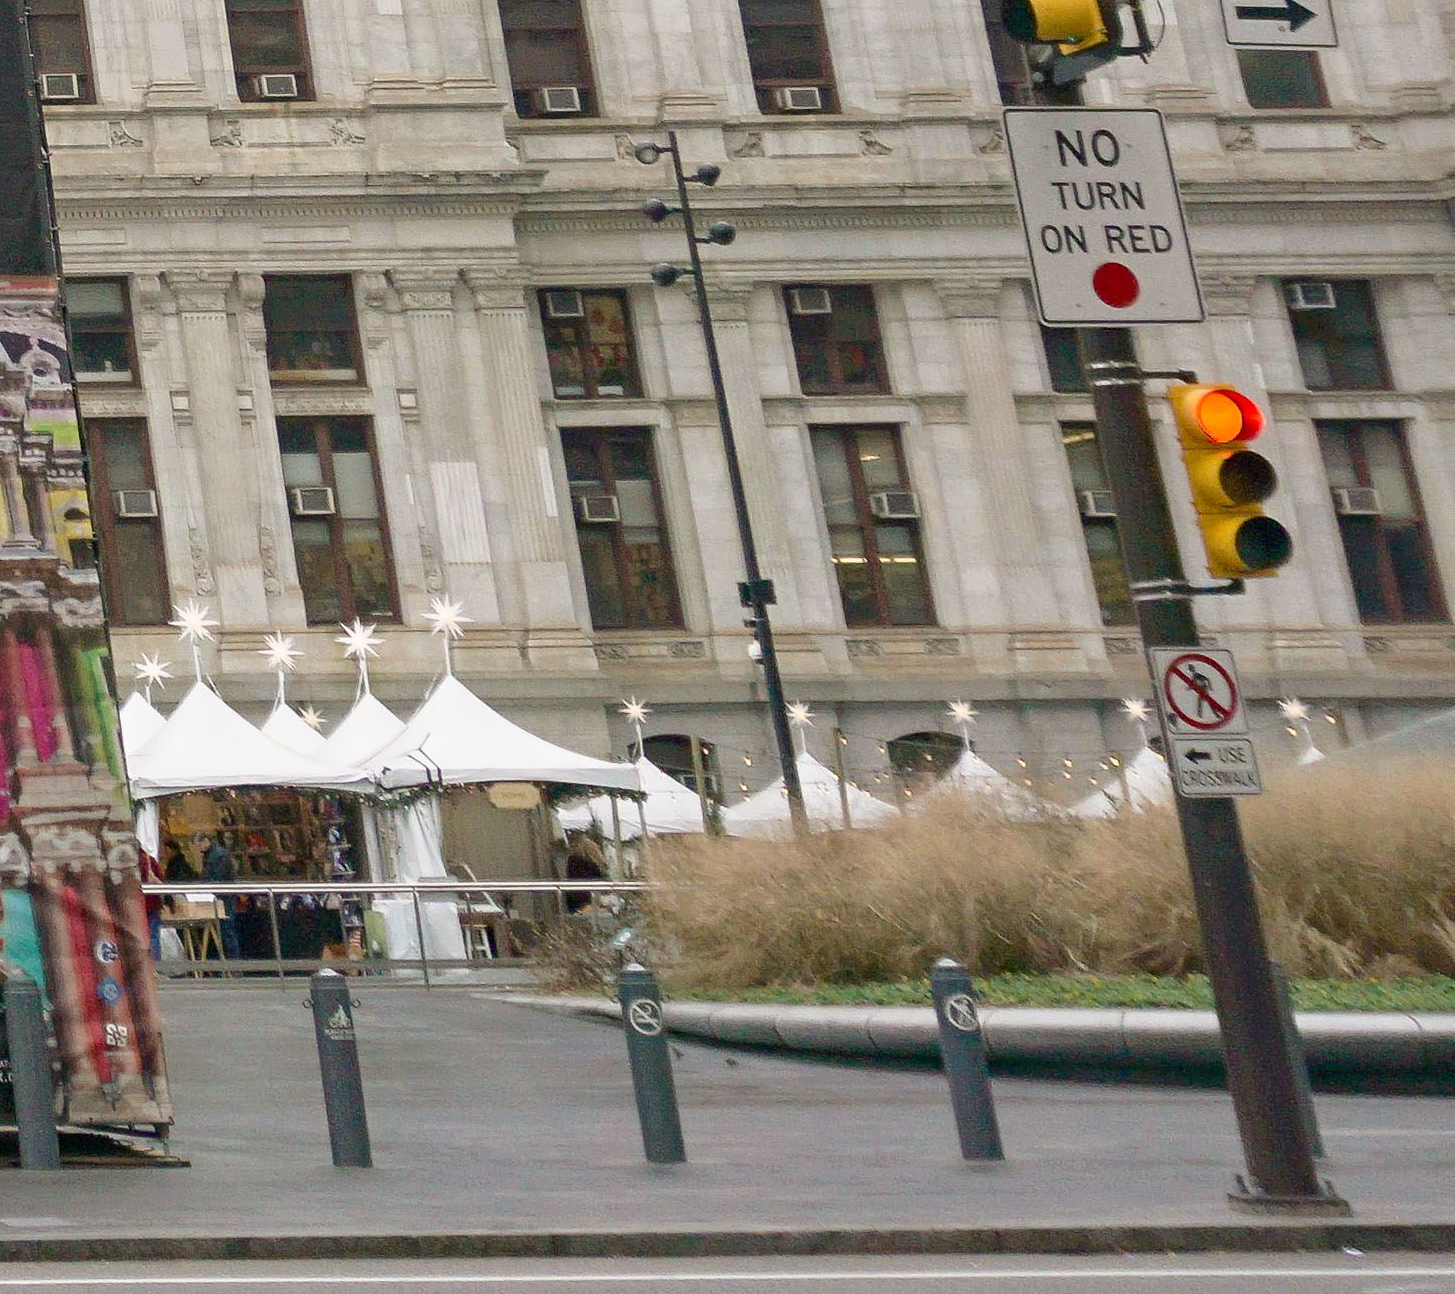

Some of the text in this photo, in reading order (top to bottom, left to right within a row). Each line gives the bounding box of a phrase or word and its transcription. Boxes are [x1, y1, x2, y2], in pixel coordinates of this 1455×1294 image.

[1056, 128, 1121, 167] NO
[1051, 181, 1146, 211] TURN
[1041, 223, 1173, 254] ON RED
[1218, 747, 1247, 763] USE
[1183, 769, 1258, 787] CROSSWALK
